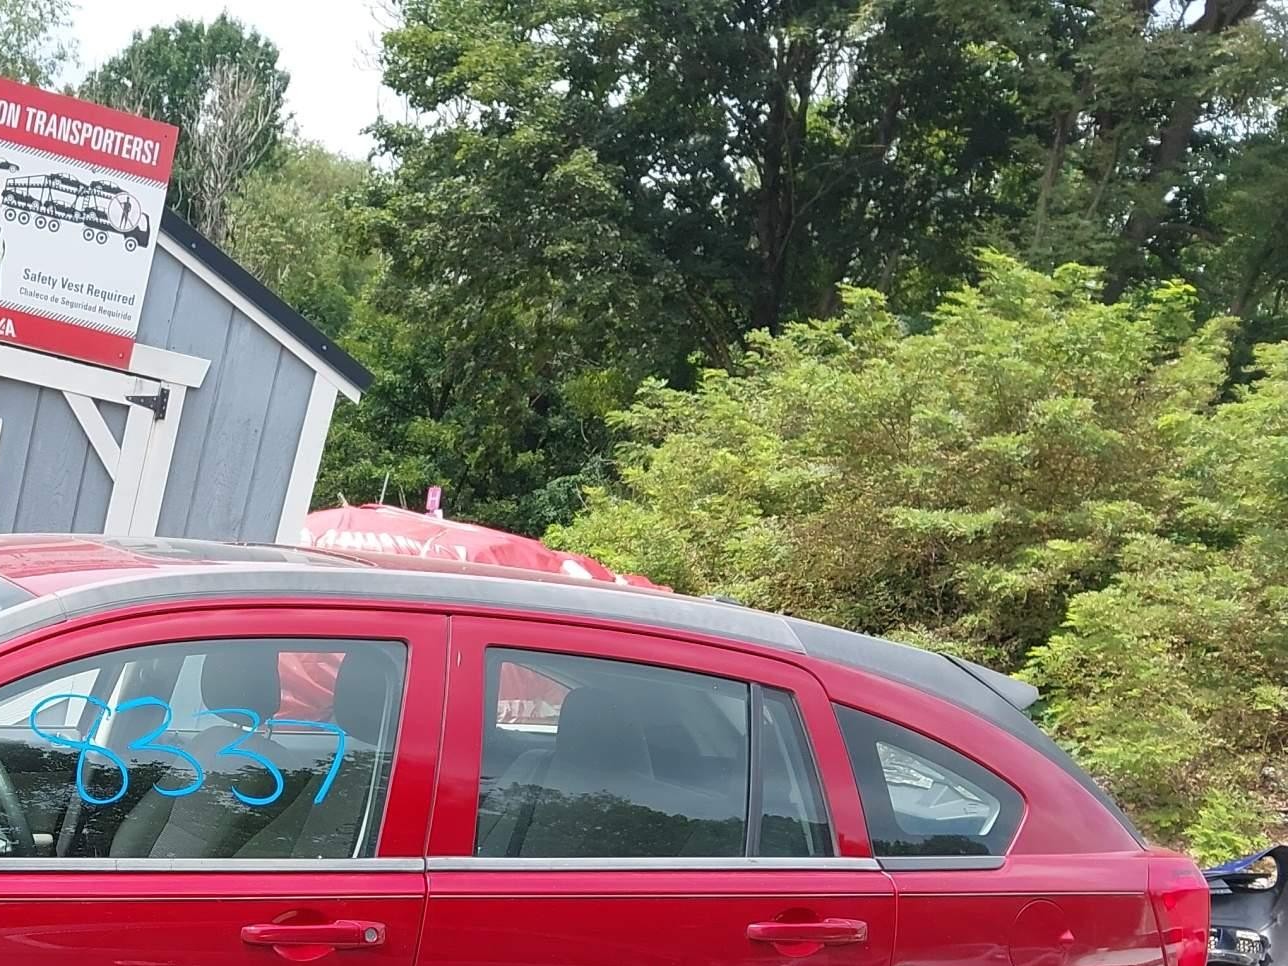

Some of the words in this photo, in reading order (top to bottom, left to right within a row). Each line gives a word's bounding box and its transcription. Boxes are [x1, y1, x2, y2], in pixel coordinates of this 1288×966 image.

[25, 107, 161, 166] TRANSPORTERS!
[19, 286, 49, 301] Chaleco
[50, 294, 59, 304] de
[61, 297, 97, 313] Seguridad
[98, 305, 132, 321] Requirido
[23, 268, 58, 290] Safety
[60, 277, 84, 294] Vest
[86, 283, 136, 306] Required
[29, 694, 348, 805] 8337
